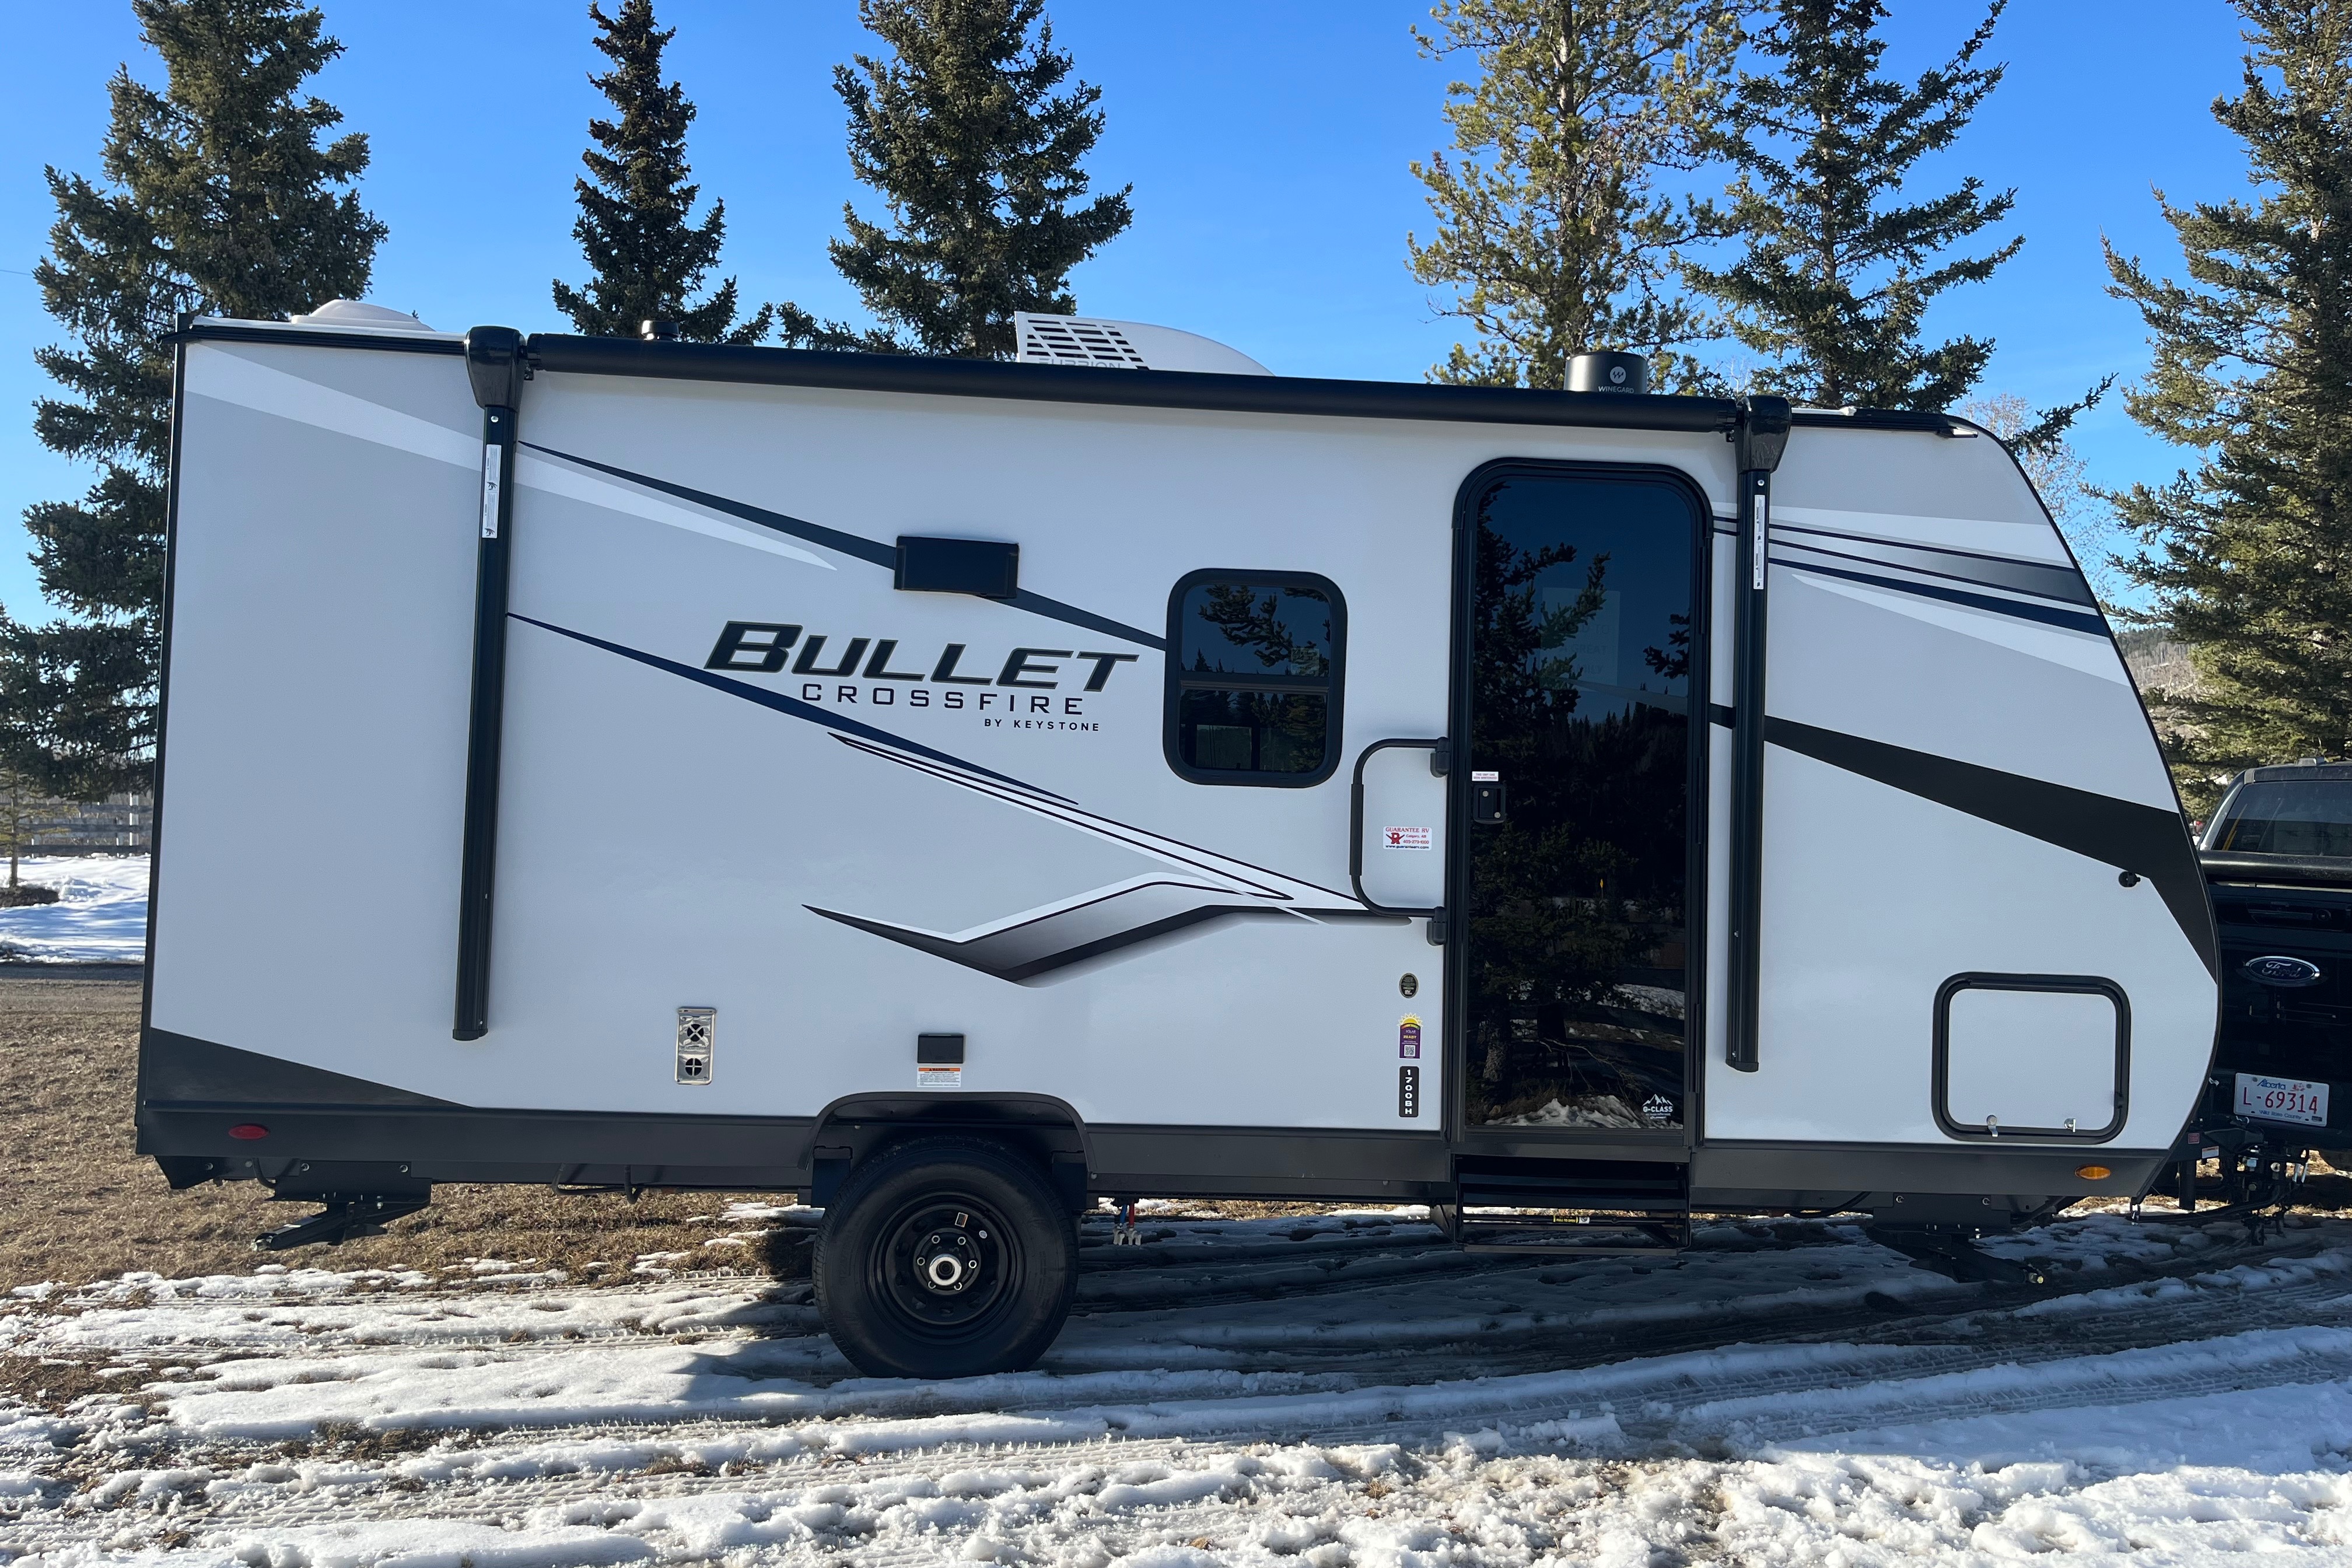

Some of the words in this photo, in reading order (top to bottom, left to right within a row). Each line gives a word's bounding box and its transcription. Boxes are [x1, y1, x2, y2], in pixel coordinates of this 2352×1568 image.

[1598, 386, 1634, 394] WINEGARD
[704, 621, 1139, 692] BULLET
[802, 684, 1083, 716] CROSSFIRE
[984, 718, 1002, 727] BY
[1013, 719, 1100, 732] KEYSTONE
[2262, 961, 2302, 978] Ford
[2256, 1078, 2287, 1090] Alberta
[2243, 1086, 2318, 1115] L-69314
